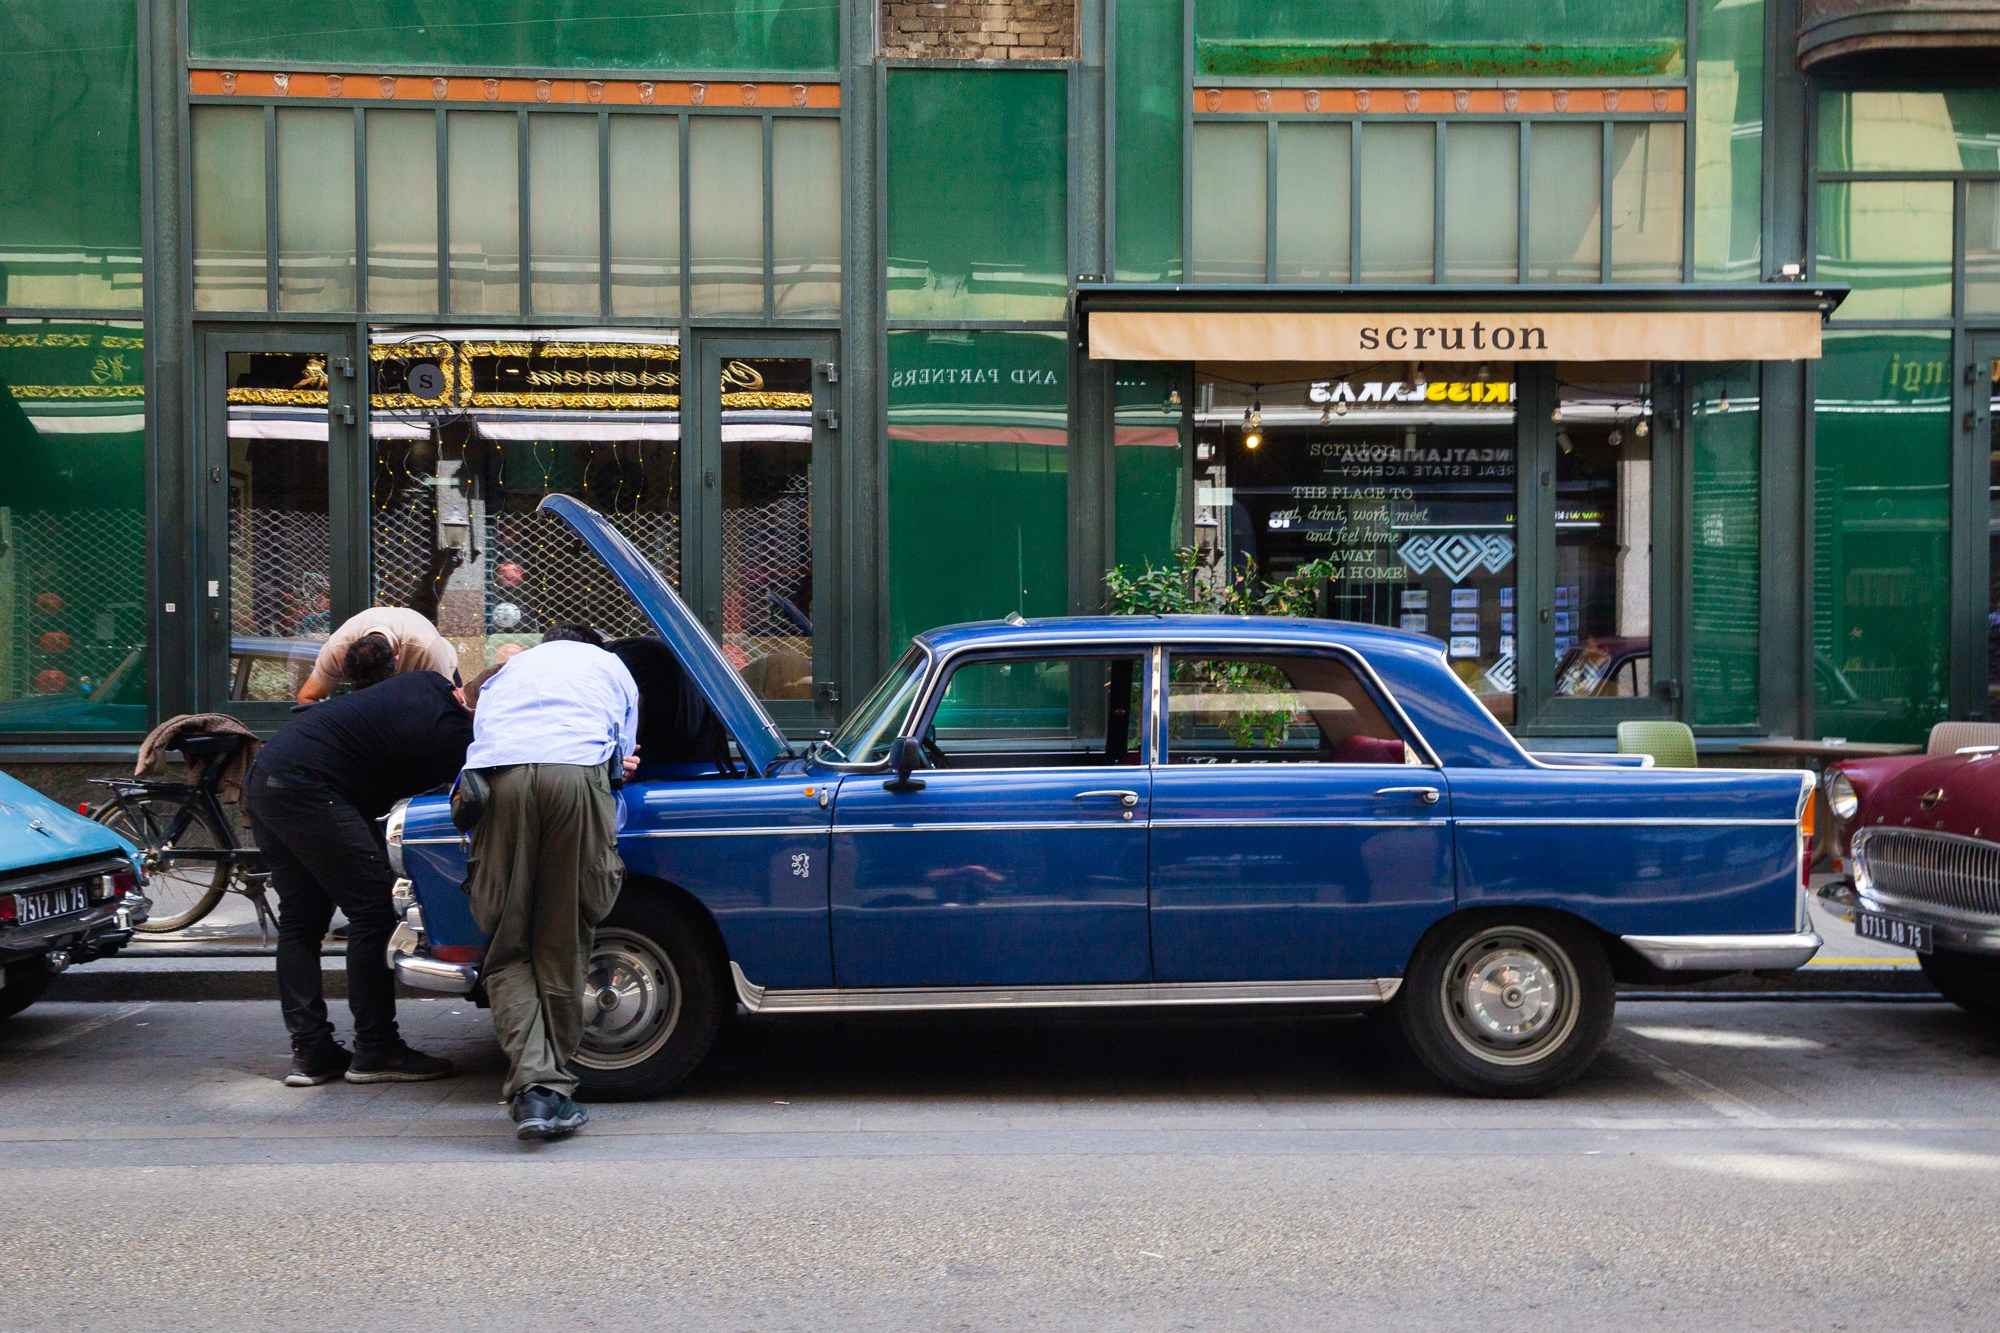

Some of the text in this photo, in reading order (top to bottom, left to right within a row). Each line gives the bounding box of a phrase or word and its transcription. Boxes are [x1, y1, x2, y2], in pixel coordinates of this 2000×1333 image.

[1359, 321, 1549, 350] scruton
[419, 374, 433, 389] S
[1309, 440, 1395, 457] scruton
[1291, 486, 1413, 500] THE PLACE TO
[1278, 505, 1429, 525] eat, drink, work, meet
[1305, 526, 1400, 546] and feel home
[1328, 549, 1376, 562] AWAY
[1349, 566, 1408, 579] HOME!
[21, 885, 85, 922] 7512 JU 75
[1908, 925, 1922, 948] 75
